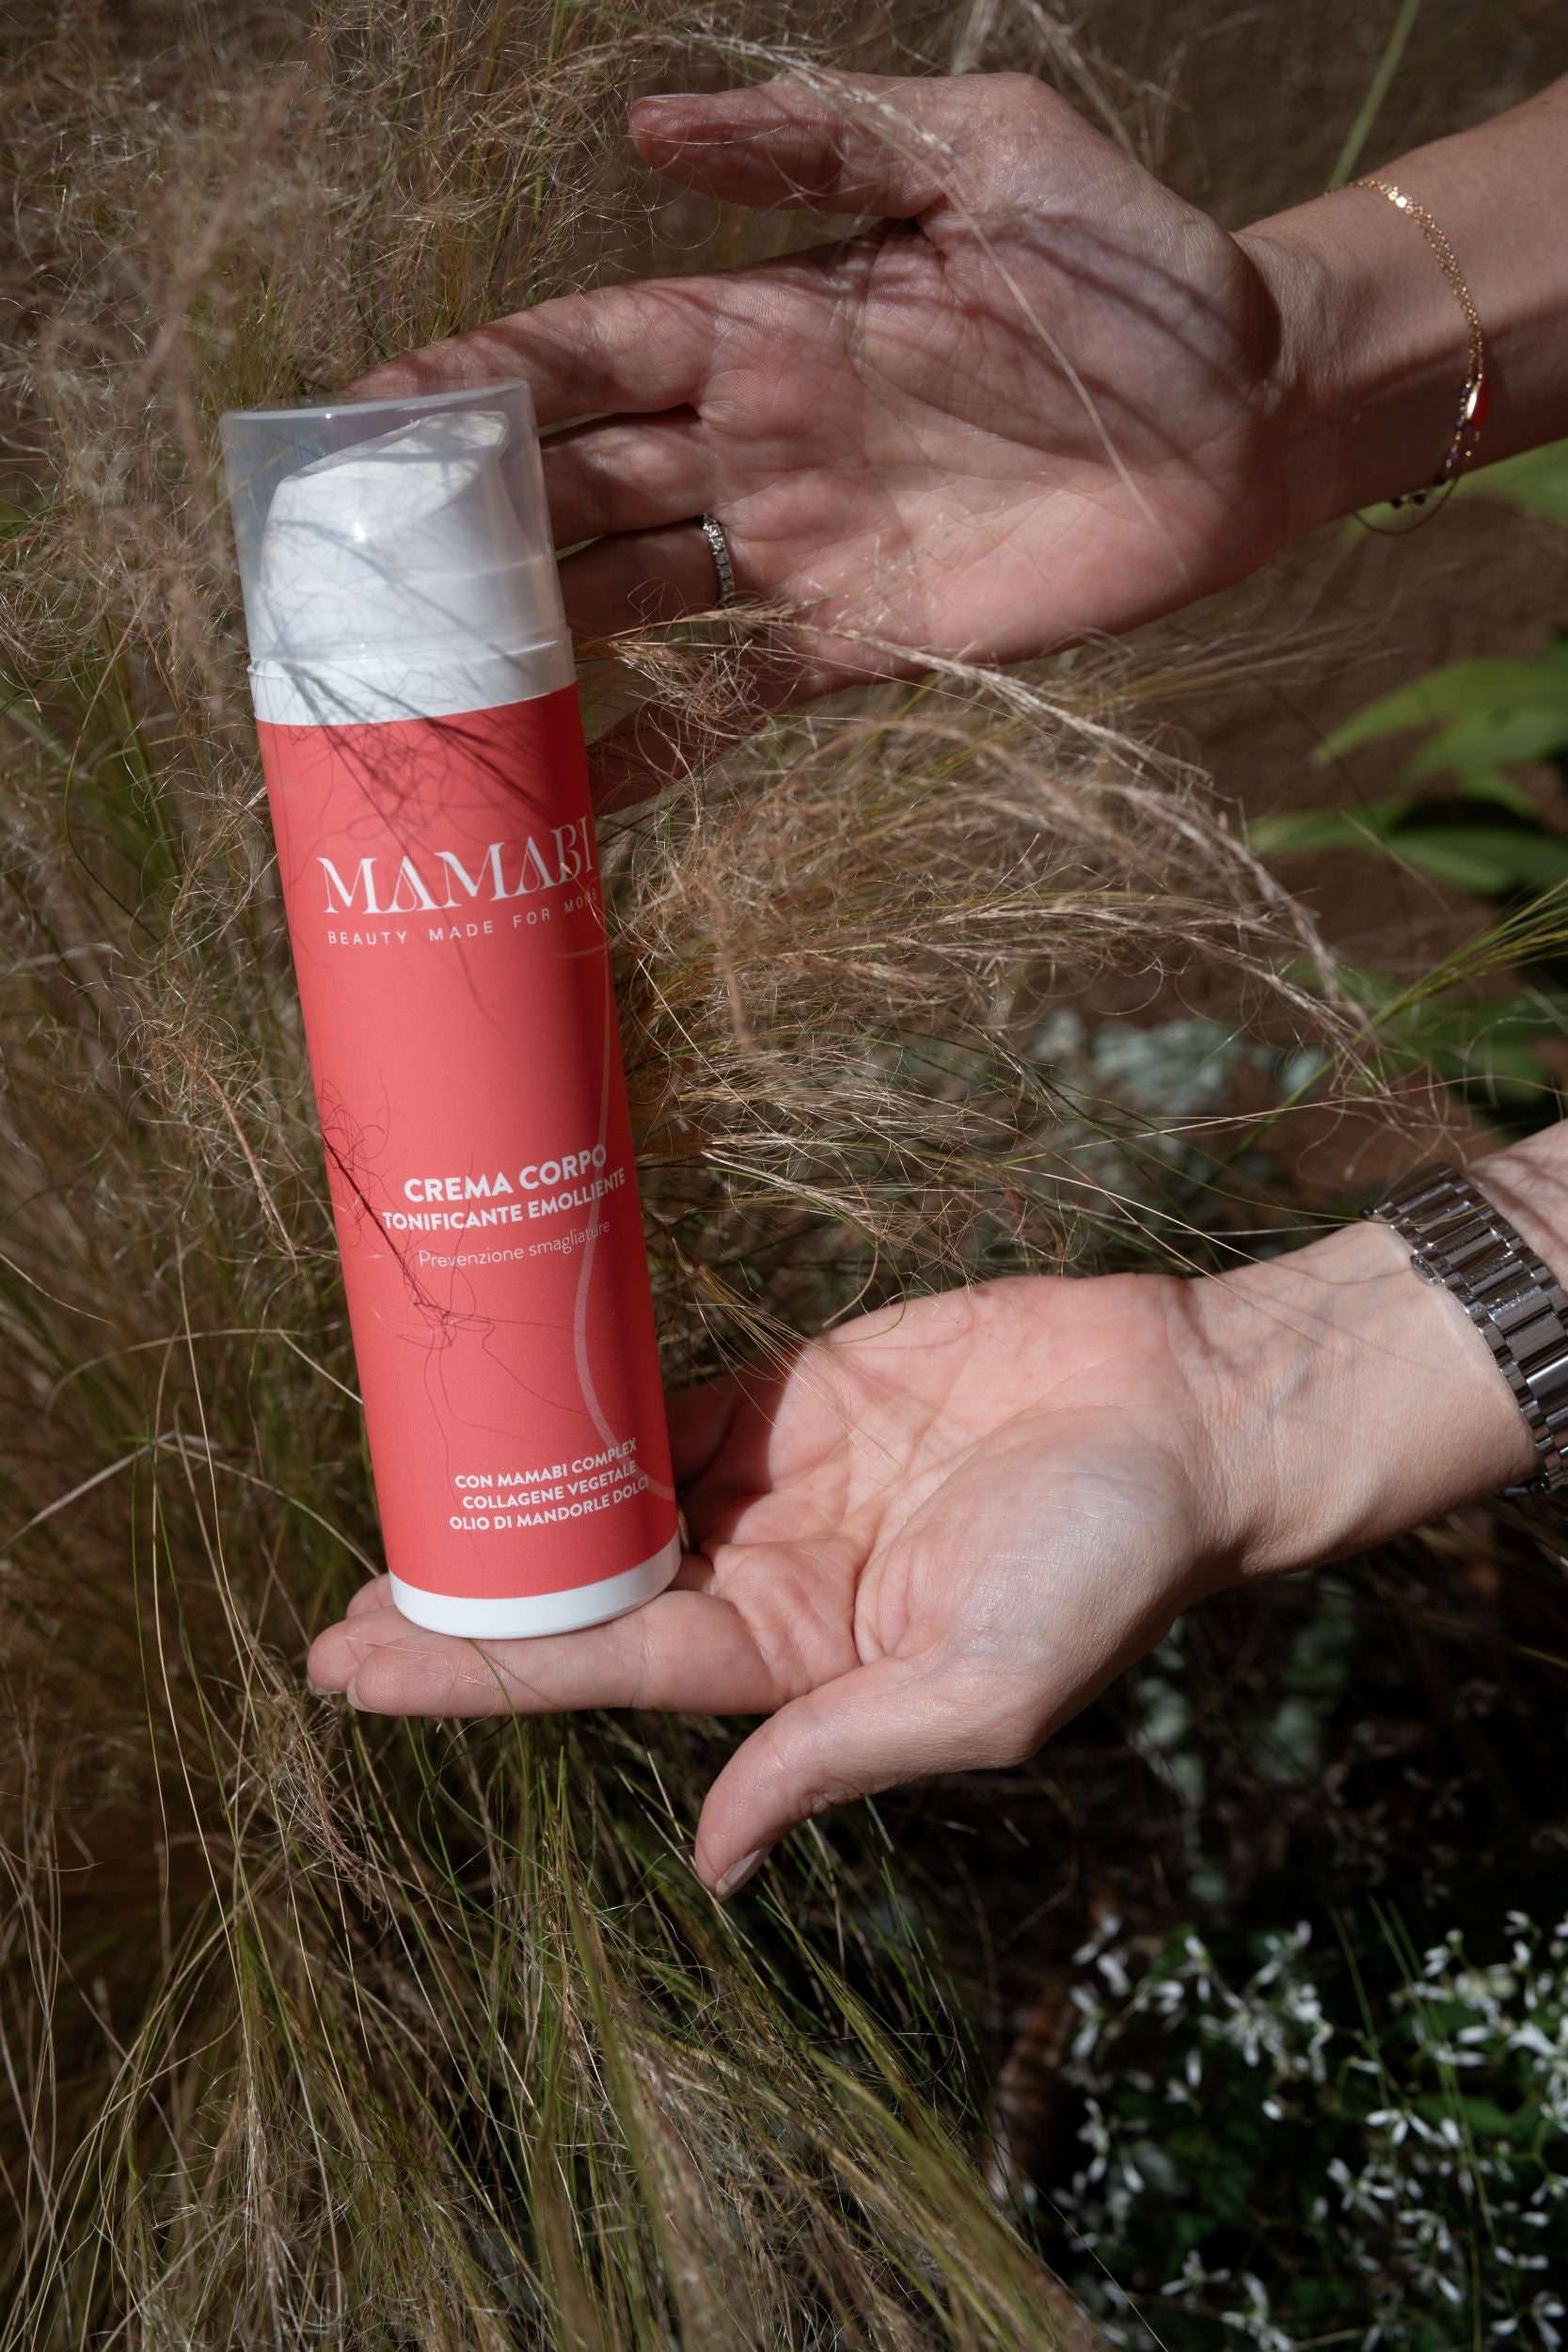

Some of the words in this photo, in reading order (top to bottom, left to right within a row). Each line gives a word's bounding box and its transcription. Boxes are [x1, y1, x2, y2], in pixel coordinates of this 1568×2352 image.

[316, 815, 594, 914] MAMABI
[327, 930, 407, 946] BEAUTY
[429, 920, 494, 942] MADE
[513, 908, 550, 929] FOR
[564, 887, 597, 914] MOMS
[382, 1204, 523, 1232] TONIFICANTE
[528, 1167, 626, 1219] EMOLLIENTE
[404, 1171, 514, 1203] CREMA
[518, 1143, 607, 1190] CORPO
[419, 1247, 524, 1268] Prevenzione
[529, 1220, 610, 1256] smagliature
[454, 1474, 492, 1489] CON
[498, 1463, 567, 1487] MAMABI
[571, 1438, 638, 1474] COMPLEX
[462, 1486, 564, 1510] COLLAGENE
[566, 1460, 637, 1497] VEGETALE
[449, 1516, 490, 1531] OLIO
[494, 1516, 513, 1530] DI
[516, 1494, 610, 1528] MANDORLE
[612, 1474, 649, 1504] DOLCI
